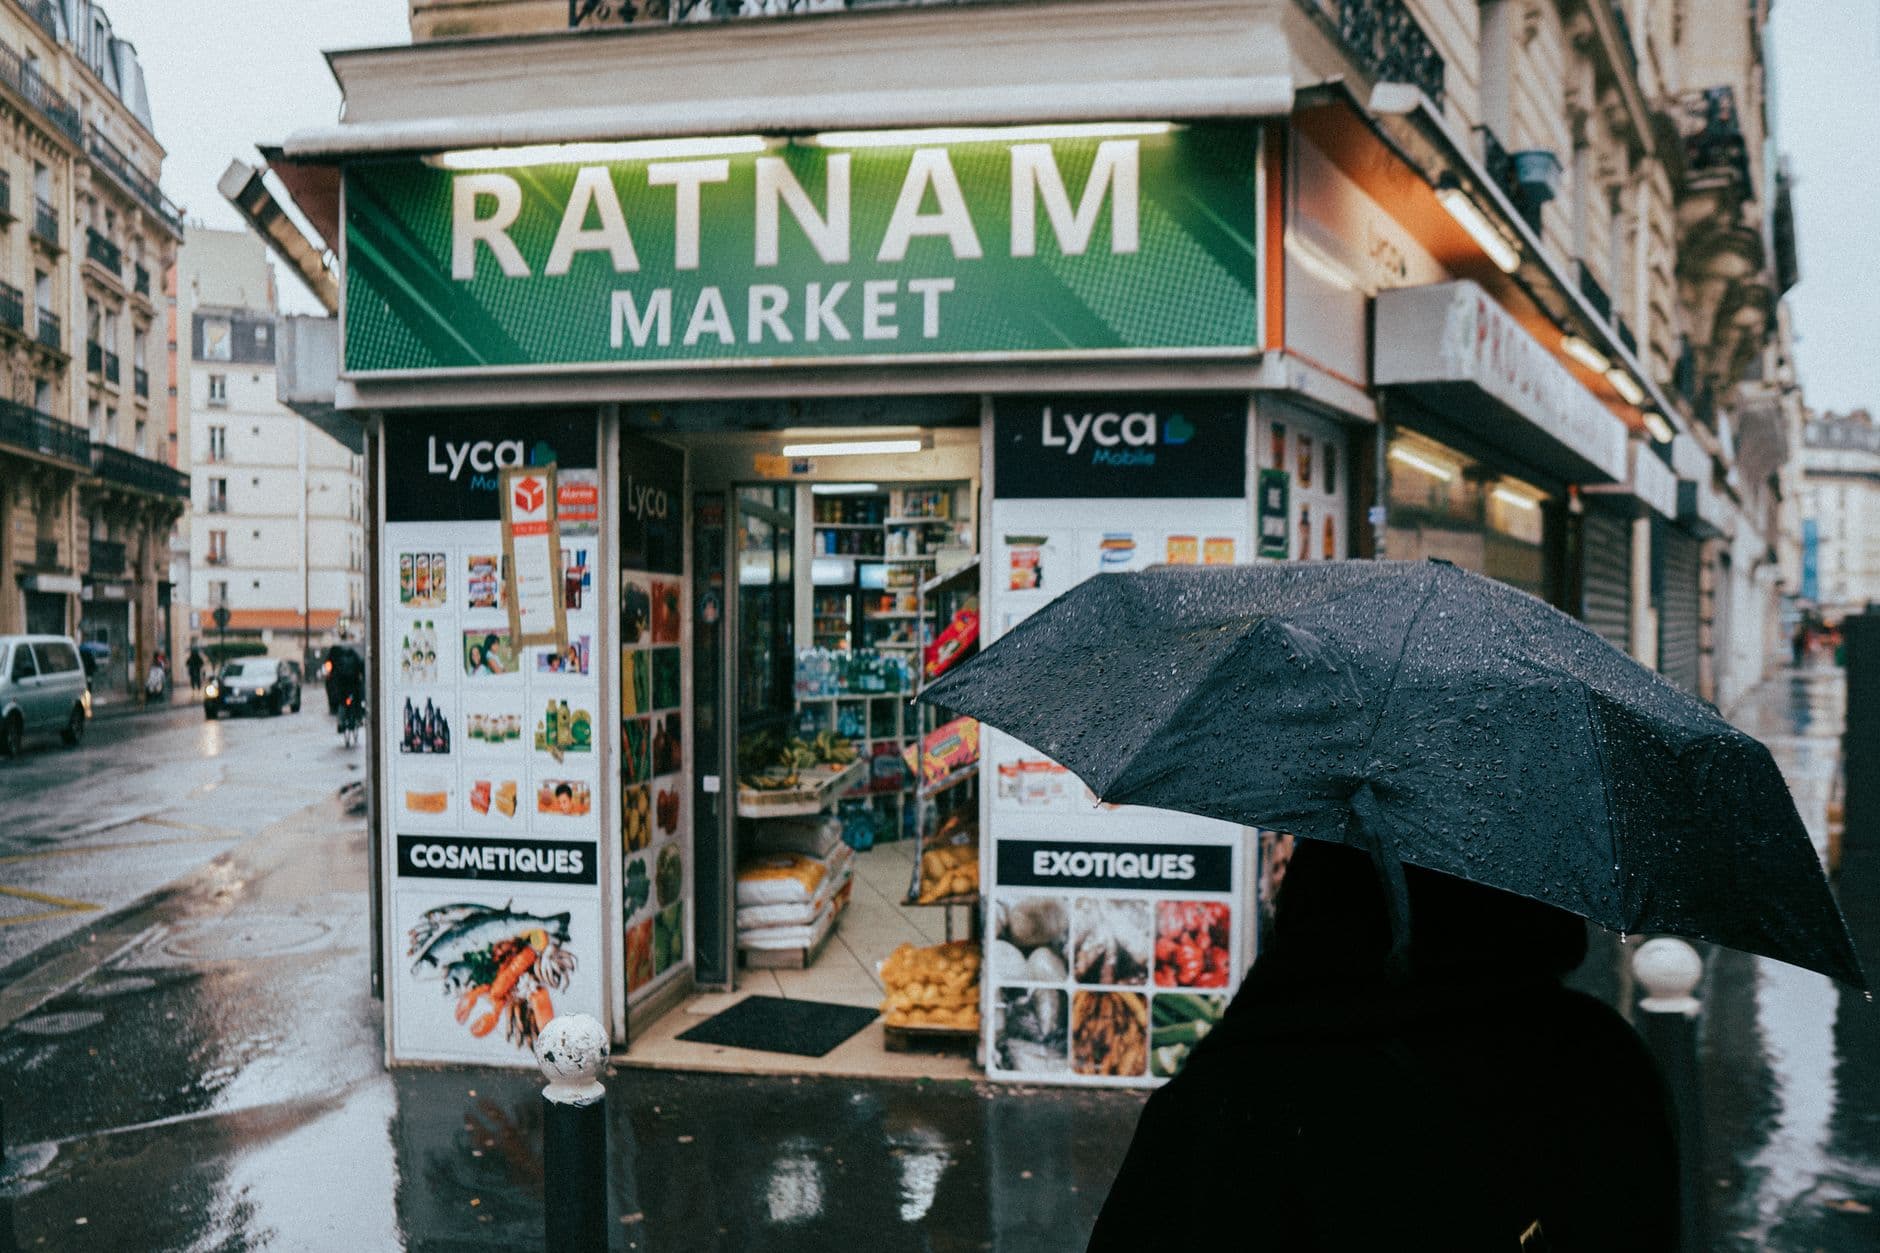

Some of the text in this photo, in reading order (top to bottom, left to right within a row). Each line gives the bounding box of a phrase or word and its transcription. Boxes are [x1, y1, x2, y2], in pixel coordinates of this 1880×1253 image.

[451, 139, 1141, 281] RATNAM
[609, 276, 956, 349] MARKET
[1042, 406, 1158, 454] Lyca
[428, 435, 525, 481] Lyca
[1092, 448, 1157, 466] Mobile
[627, 475, 668, 521] Lyca
[410, 843, 584, 874] COSMETIQUES
[1032, 850, 1197, 881] EXOTIQUES
